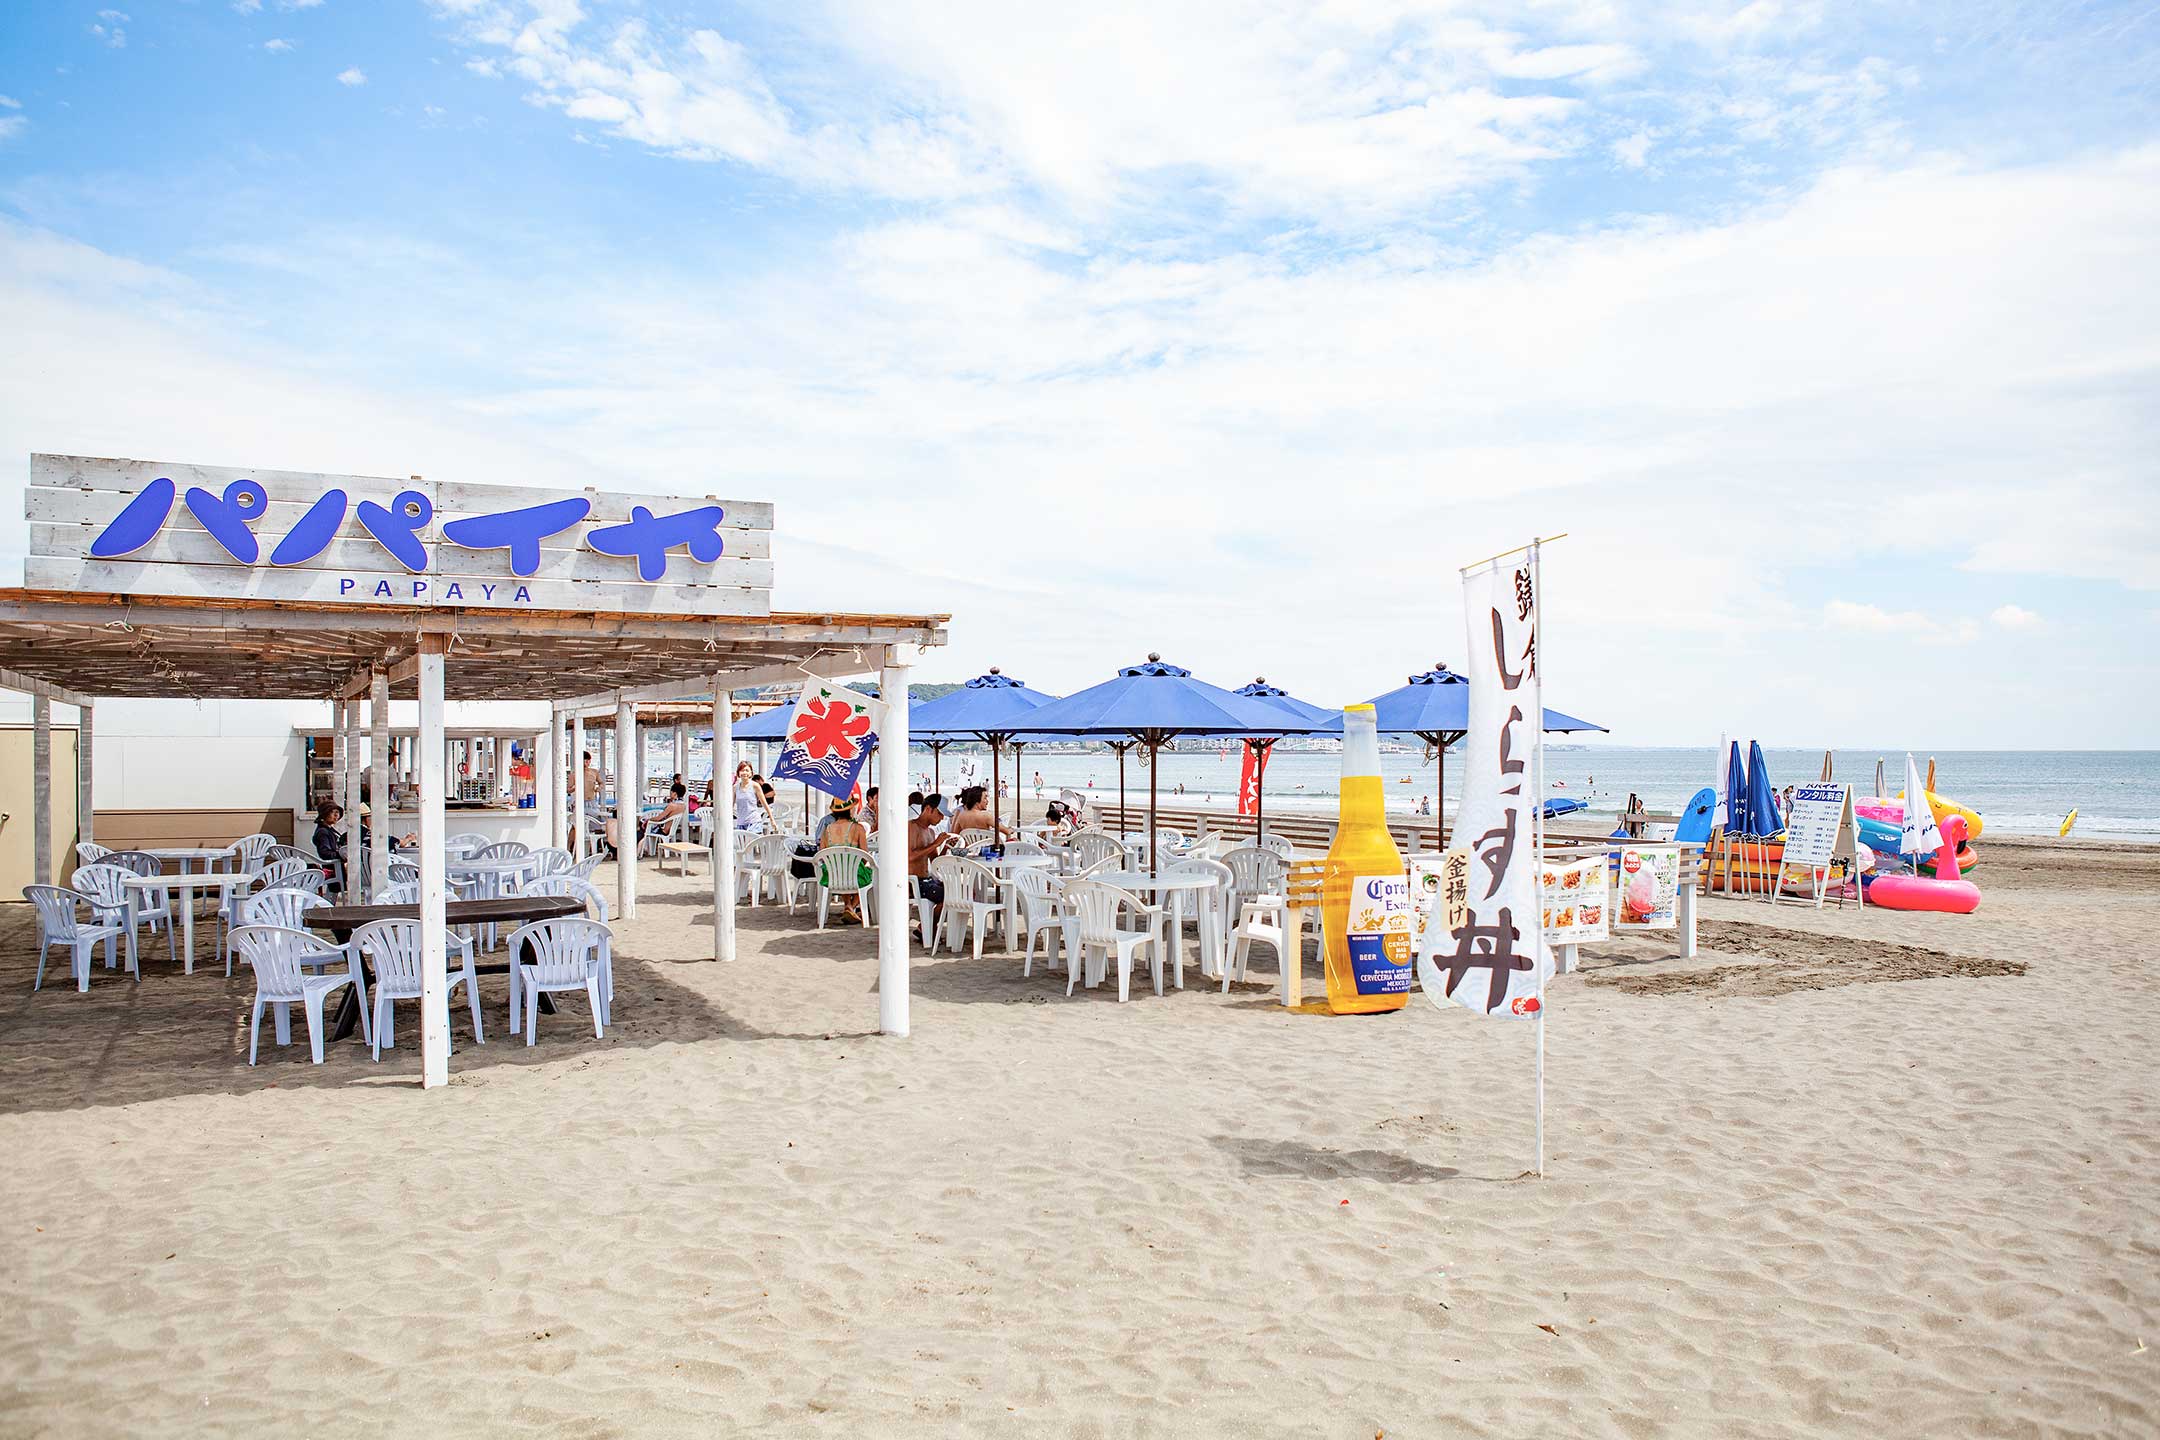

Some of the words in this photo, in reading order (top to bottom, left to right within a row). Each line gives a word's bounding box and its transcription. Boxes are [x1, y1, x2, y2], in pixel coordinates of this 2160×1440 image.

[91, 478, 724, 582] パパイヤ
[340, 578, 532, 602] PAPAYA
[1433, 607, 1534, 1015] しらす丼
[1797, 791, 1843, 801] レンタル料金
[1366, 880, 1408, 901] Coro
[1445, 854, 1467, 925] 釜揚げ
